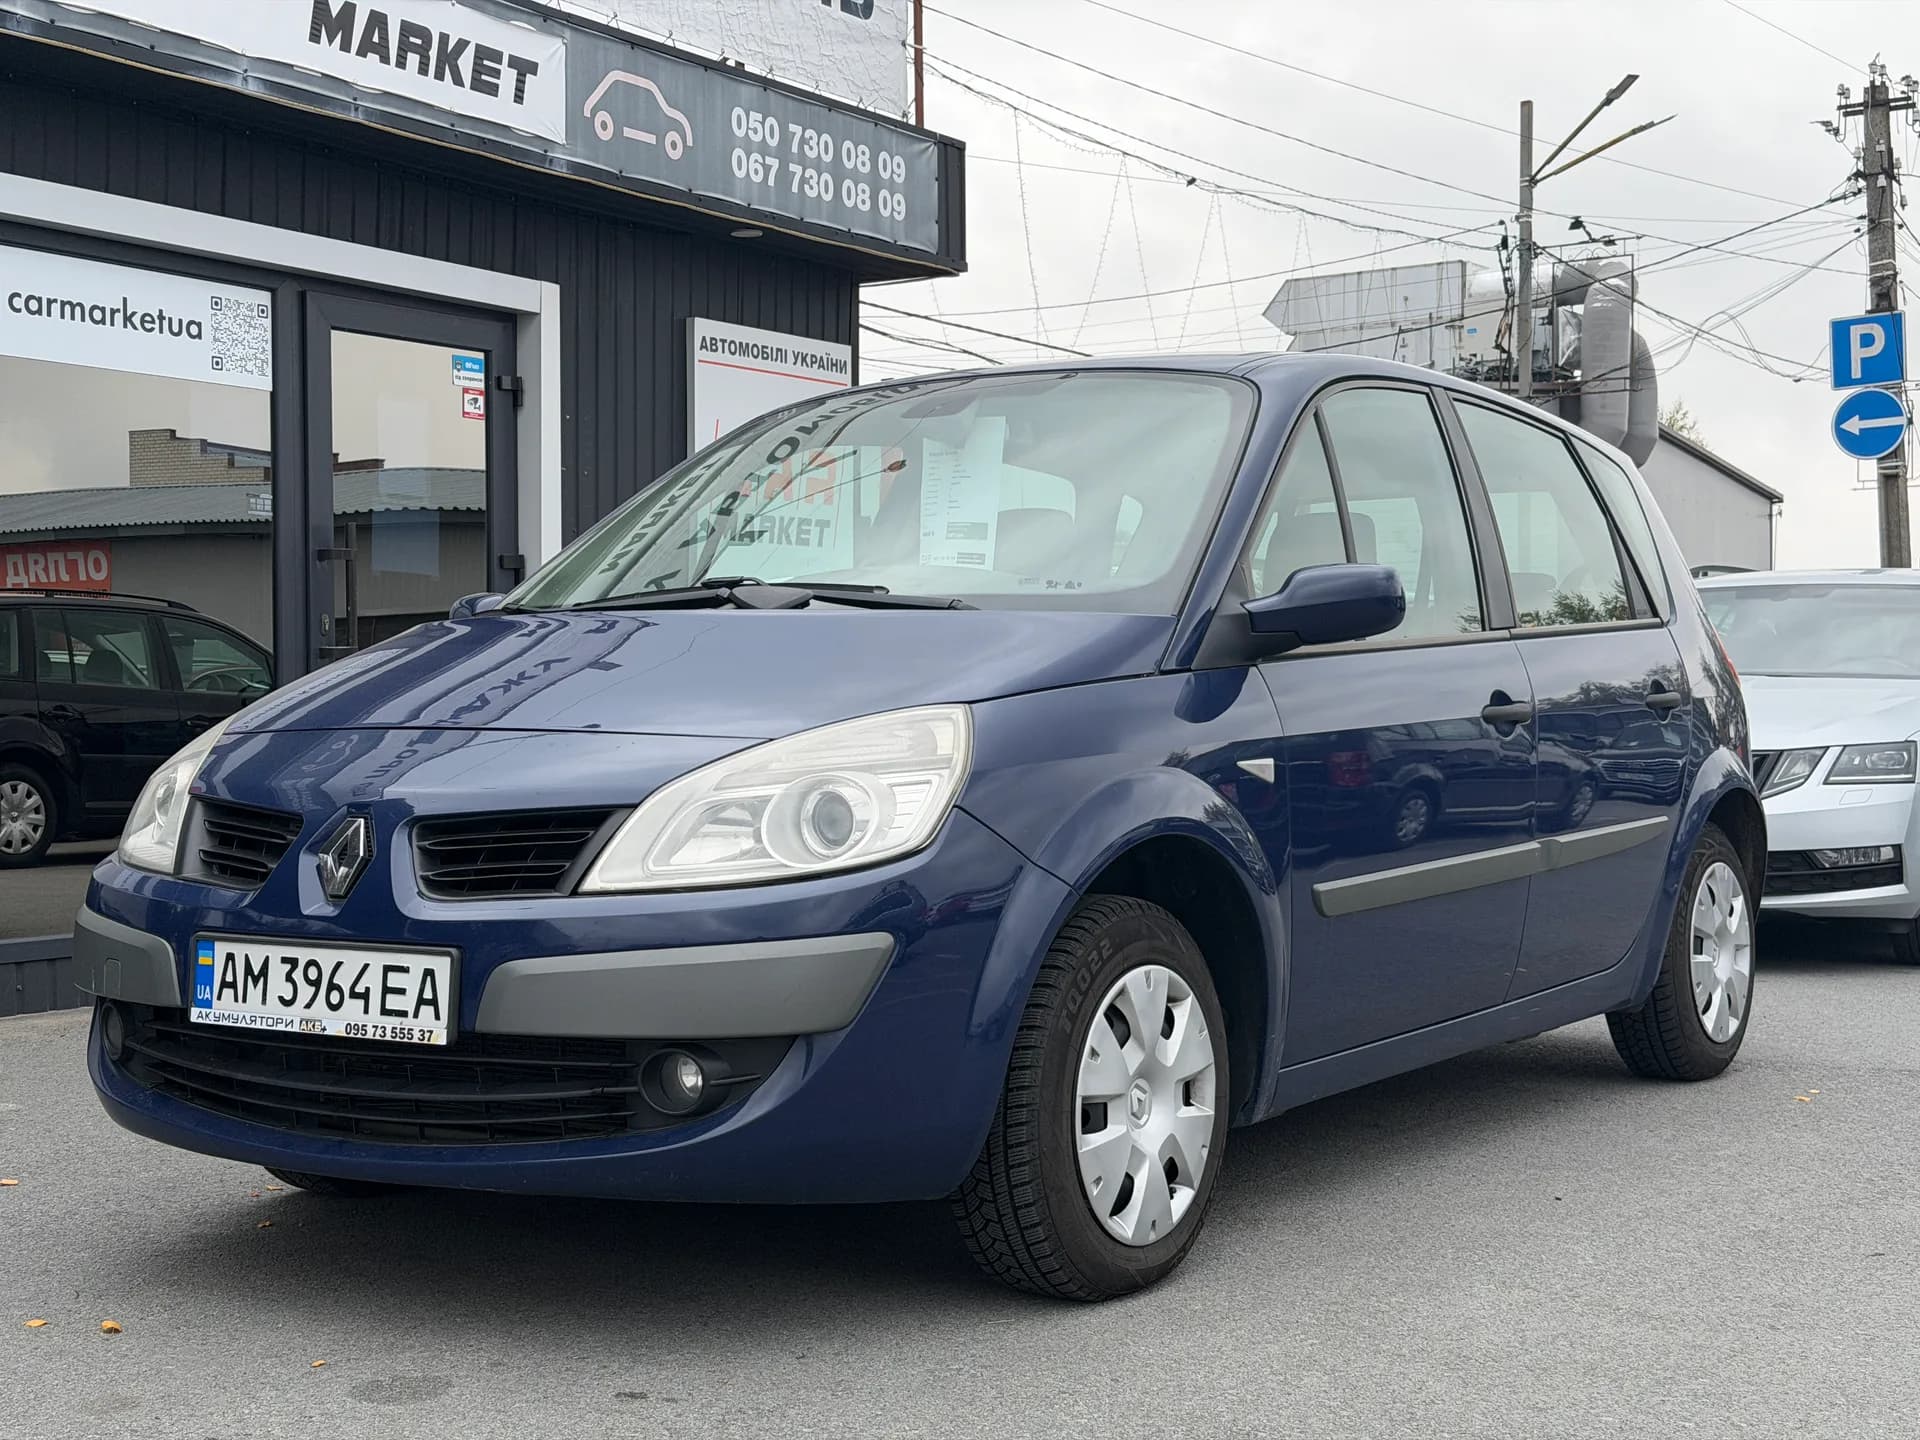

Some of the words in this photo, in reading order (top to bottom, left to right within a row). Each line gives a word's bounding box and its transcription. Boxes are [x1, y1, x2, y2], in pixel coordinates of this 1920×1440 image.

[308, 0, 538, 104] MARKET
[731, 107, 780, 147] 050
[789, 123, 834, 163] 730
[842, 140, 871, 174] 08
[878, 151, 906, 184] 09
[731, 147, 780, 187] 067
[789, 163, 834, 201] 730
[842, 179, 871, 211] 08
[878, 189, 906, 221] 09
[8, 291, 203, 340] carmarketua
[699, 335, 788, 364] АВТОМОБІЛІ
[792, 350, 848, 375] УКРАЇНИ
[1849, 323, 1885, 379] P
[197, 984, 211, 1000] UA
[196, 1010, 295, 1029] АКУМУЛЯТОРИ
[344, 1022, 368, 1038] 095
[372, 1025, 387, 1039] 73
[390, 1026, 414, 1041] 555
[417, 1027, 434, 1042] 37
